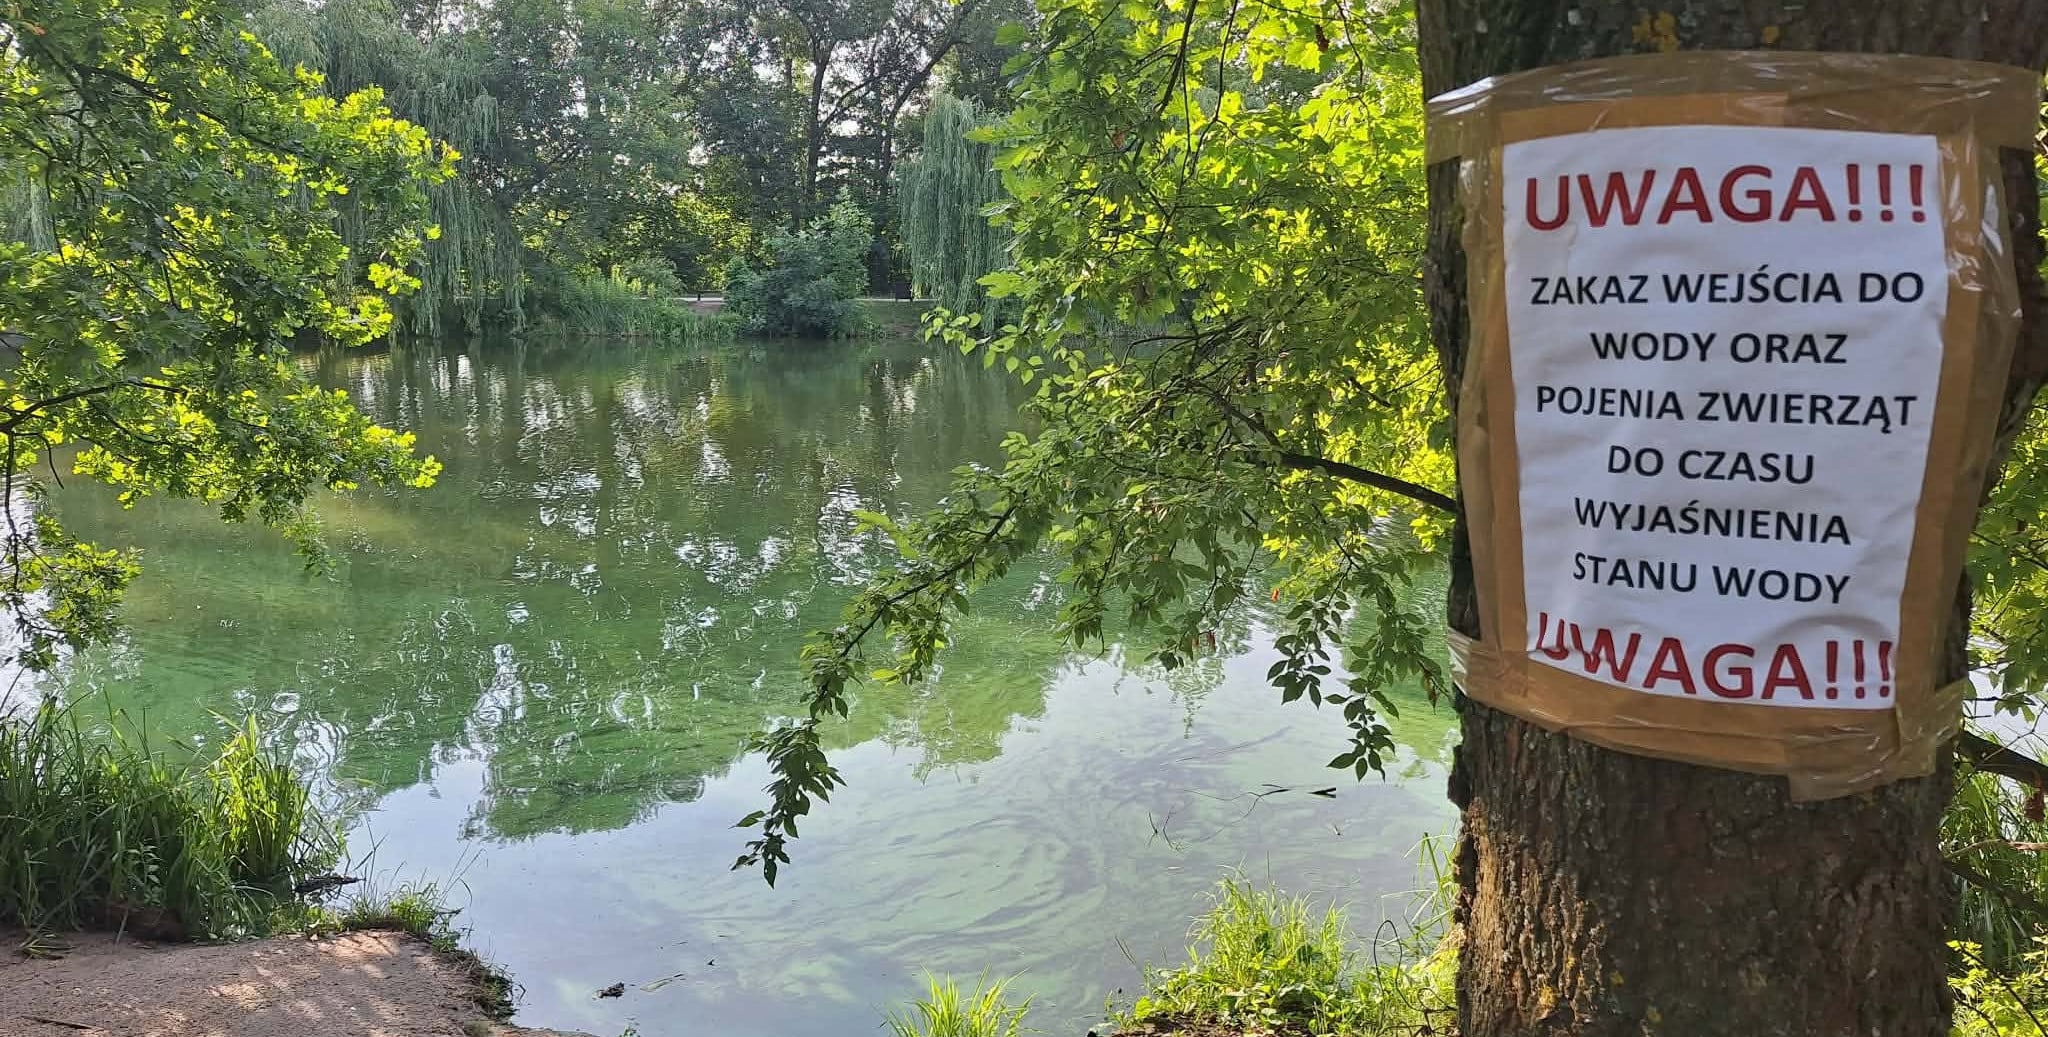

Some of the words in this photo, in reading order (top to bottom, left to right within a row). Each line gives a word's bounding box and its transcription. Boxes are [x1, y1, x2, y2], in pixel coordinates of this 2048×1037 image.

[1525, 163, 1926, 232] UWAGA!!!
[1530, 276, 1649, 305] ZAKAZ
[1661, 264, 1843, 304] WEJŚCIA
[1858, 271, 1924, 303] DO
[1590, 332, 1717, 362] WODY
[1729, 333, 1849, 364] ORAZ
[1536, 385, 1685, 421] POJENIA
[1696, 391, 1918, 434] ZWIERZĄT
[1607, 445, 1664, 477] DO
[1677, 449, 1814, 485] CZASU
[1574, 496, 1851, 546] WYJAŚNIENIA
[1573, 551, 1697, 593] STANU
[1711, 565, 1851, 605] WODY
[1535, 612, 1894, 700] UWAGA!!!
